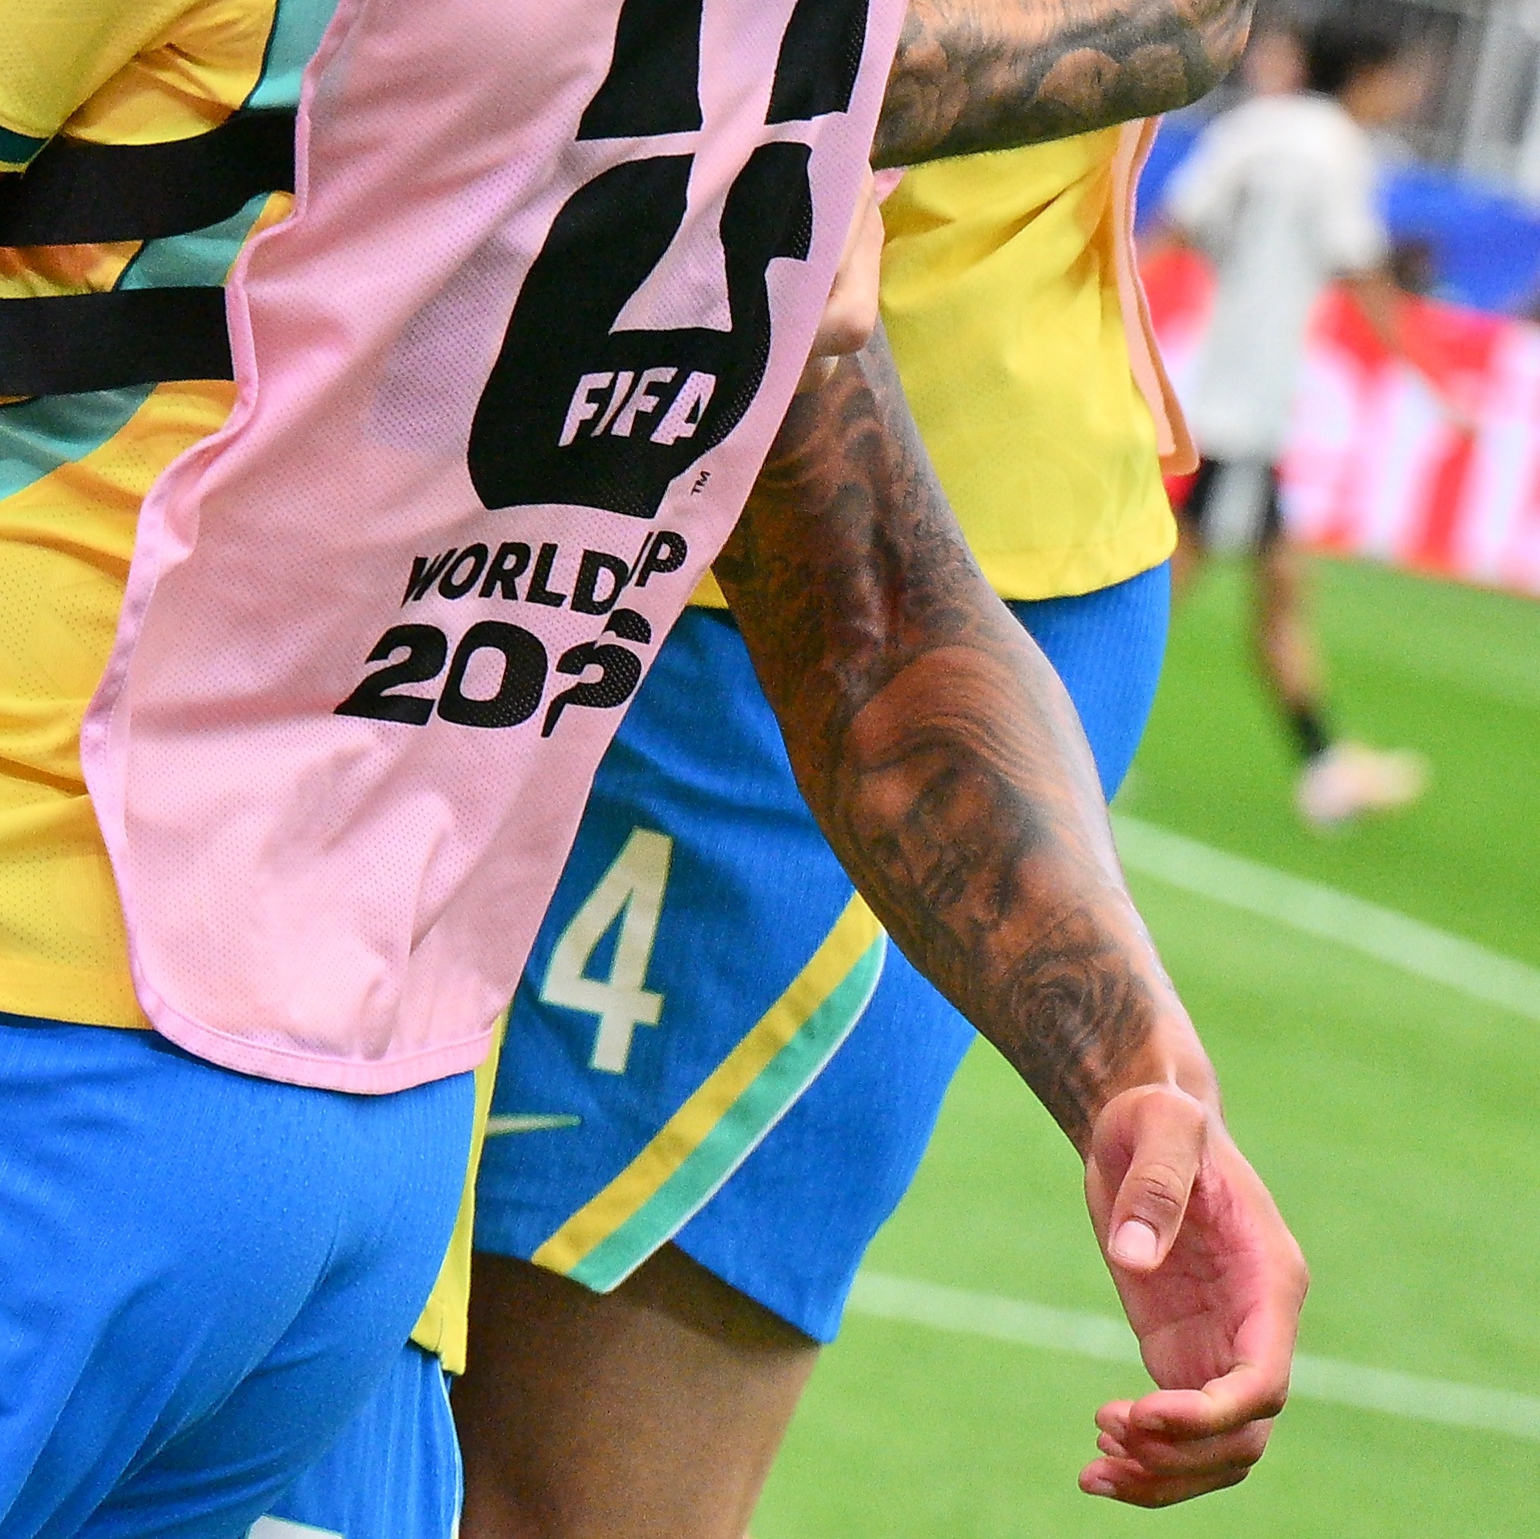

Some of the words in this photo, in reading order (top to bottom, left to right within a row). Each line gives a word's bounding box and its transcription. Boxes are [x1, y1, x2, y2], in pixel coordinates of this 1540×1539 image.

[557, 367, 716, 448] FIFA
[401, 542, 629, 616] WORLD
[539, 825, 674, 1075] 4
